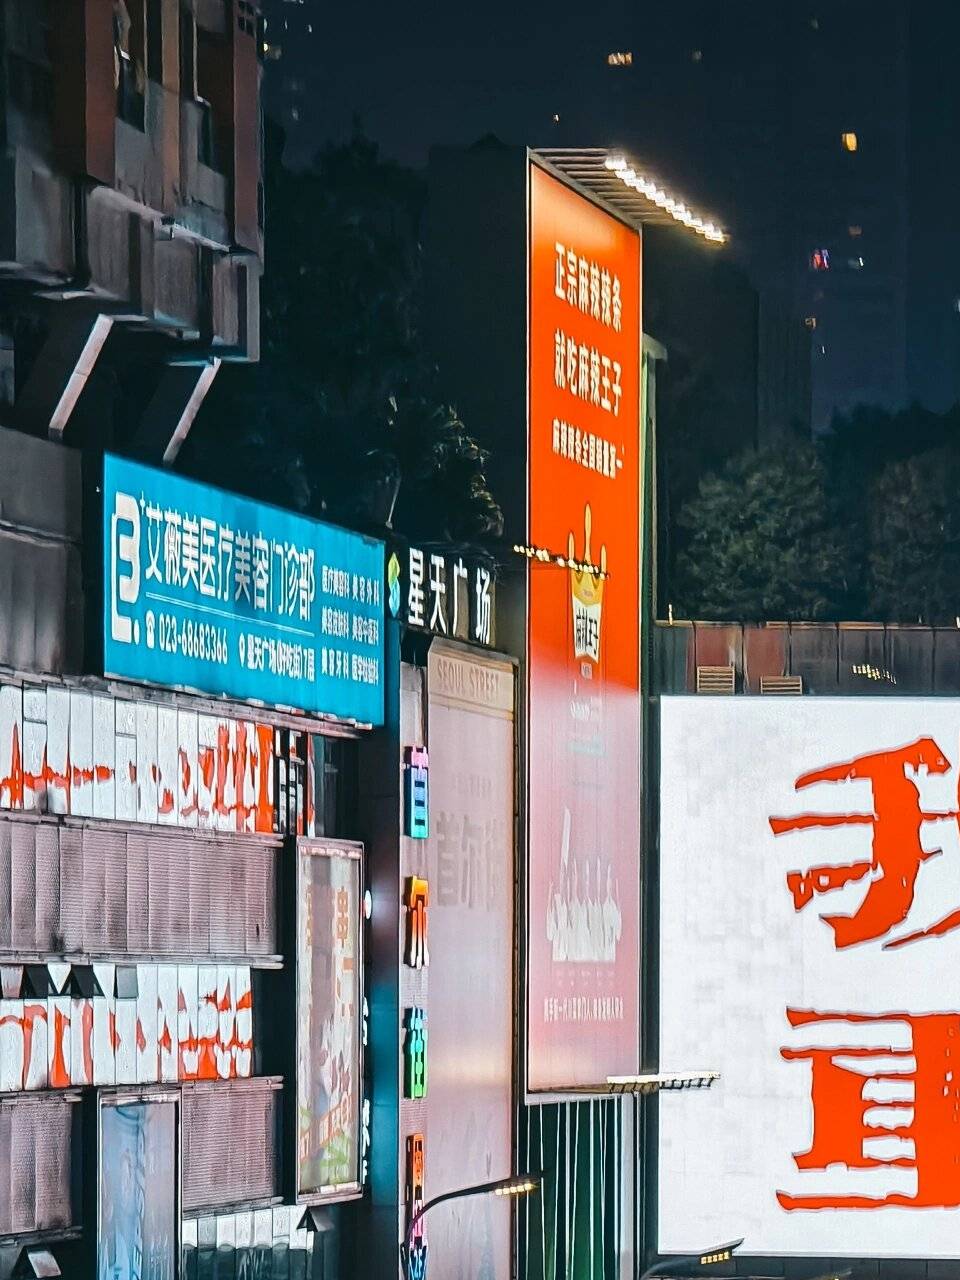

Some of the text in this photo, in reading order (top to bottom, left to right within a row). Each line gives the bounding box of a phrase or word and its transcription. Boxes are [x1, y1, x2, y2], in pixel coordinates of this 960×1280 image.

[554, 241, 622, 332] 正宗麻辣辣条
[554, 328, 622, 416] 就吃麻辣王子
[146, 500, 314, 622] 艾薇美医疗美容门诊部
[408, 547, 491, 645] 星天广场
